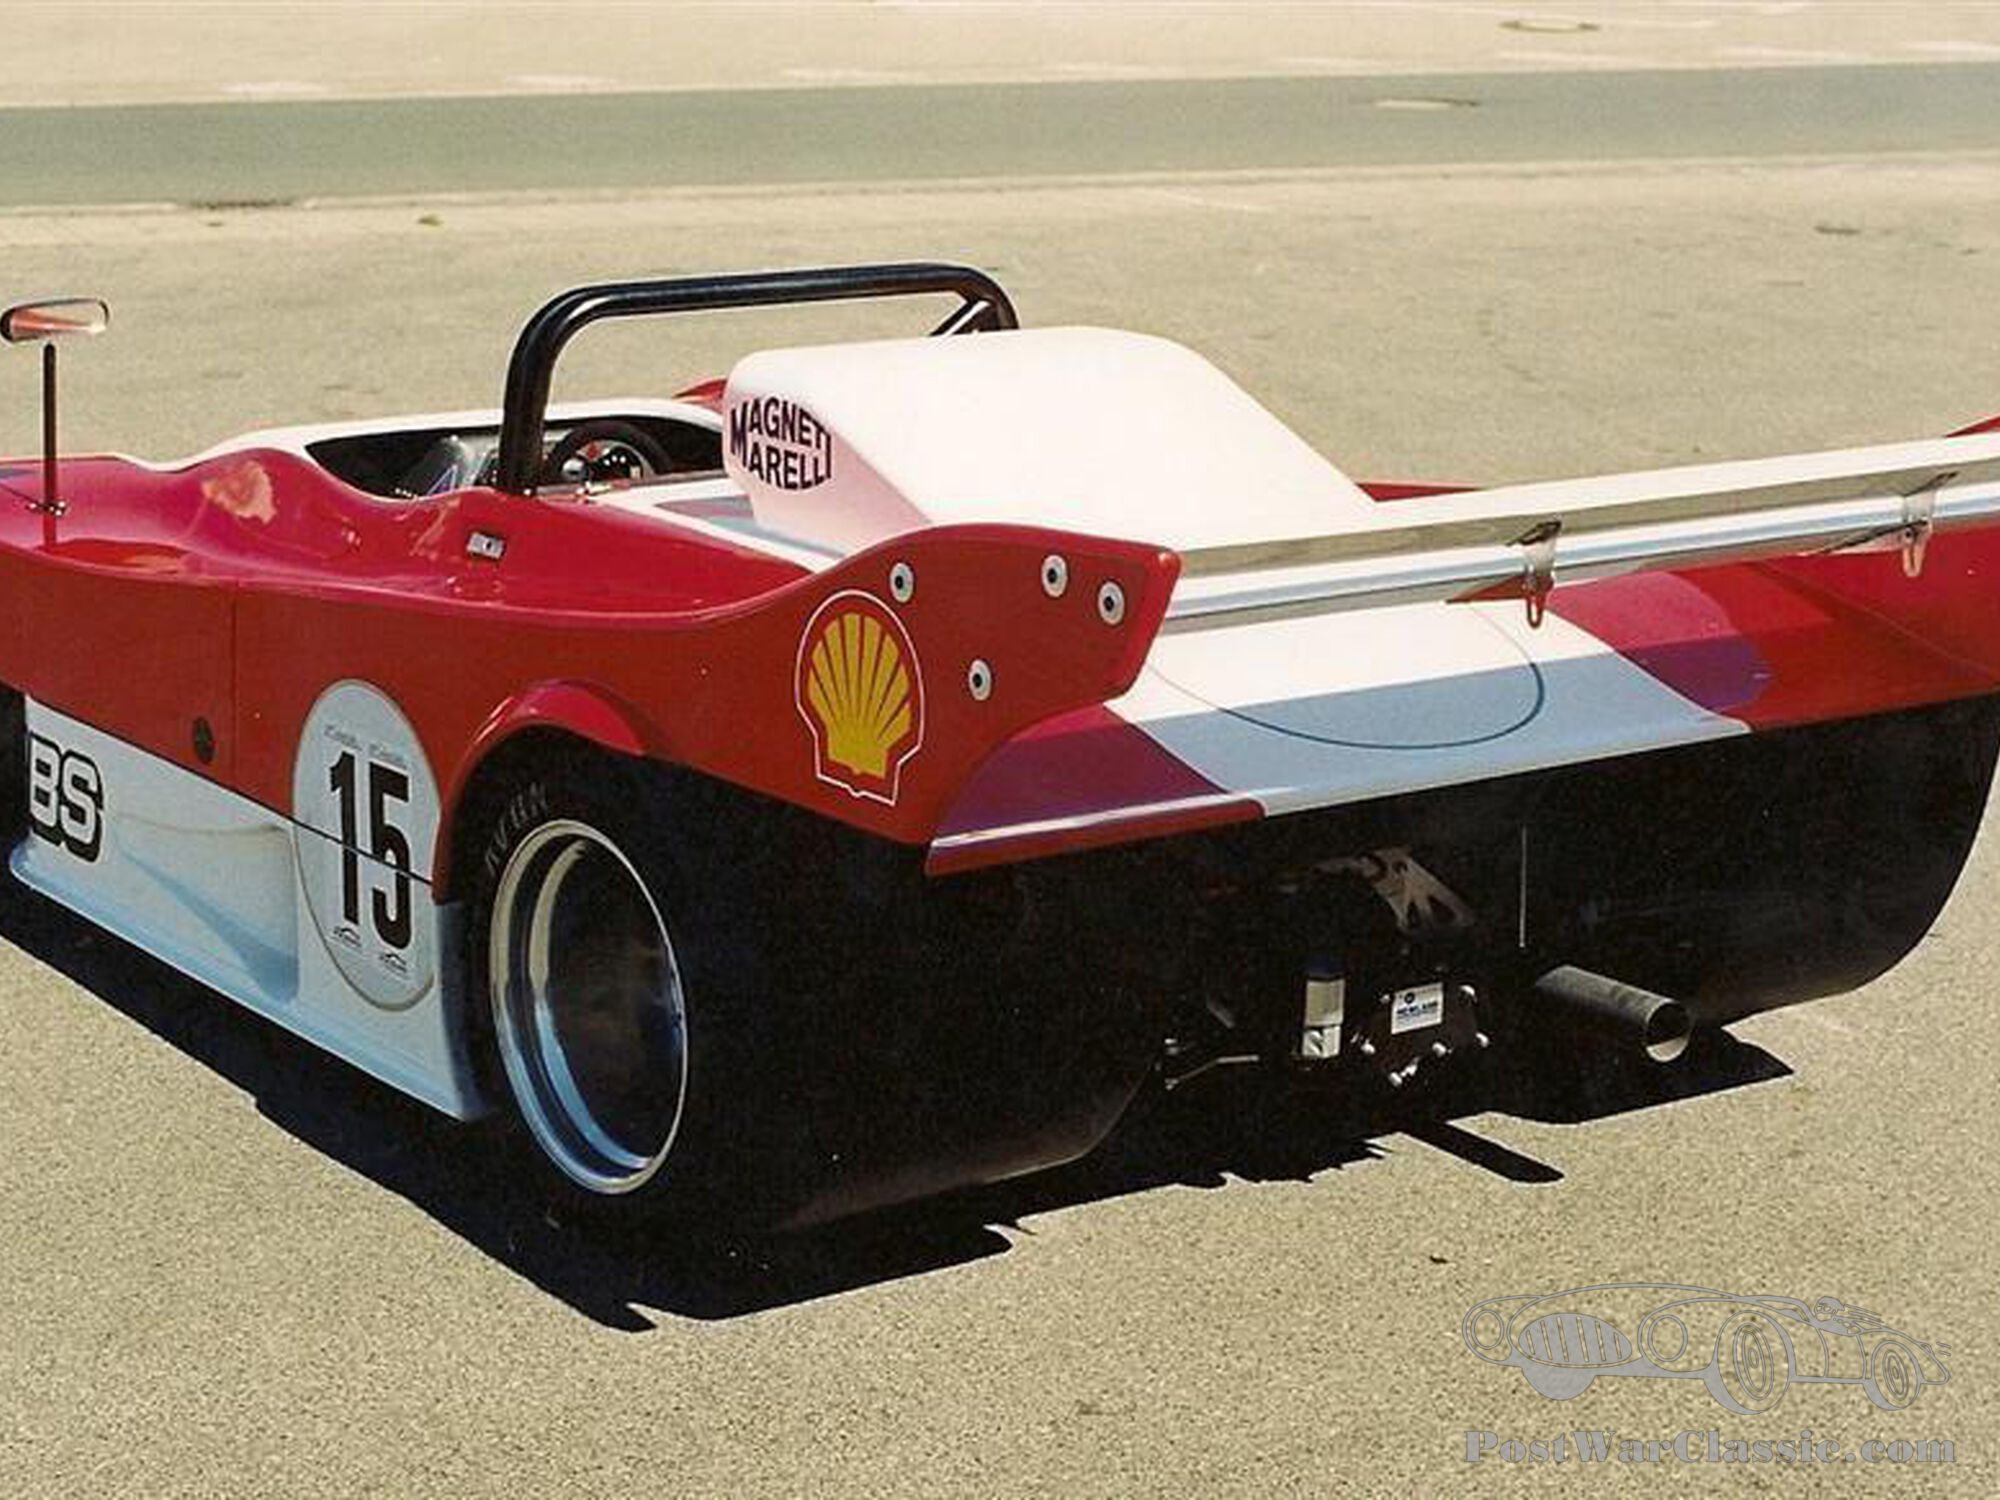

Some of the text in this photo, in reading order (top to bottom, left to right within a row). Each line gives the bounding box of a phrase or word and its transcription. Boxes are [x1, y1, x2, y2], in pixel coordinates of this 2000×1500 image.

[730, 396, 832, 457] MAGNETI
[730, 438, 832, 490] MARELLI
[29, 731, 104, 862] BS
[329, 750, 411, 950] 15
